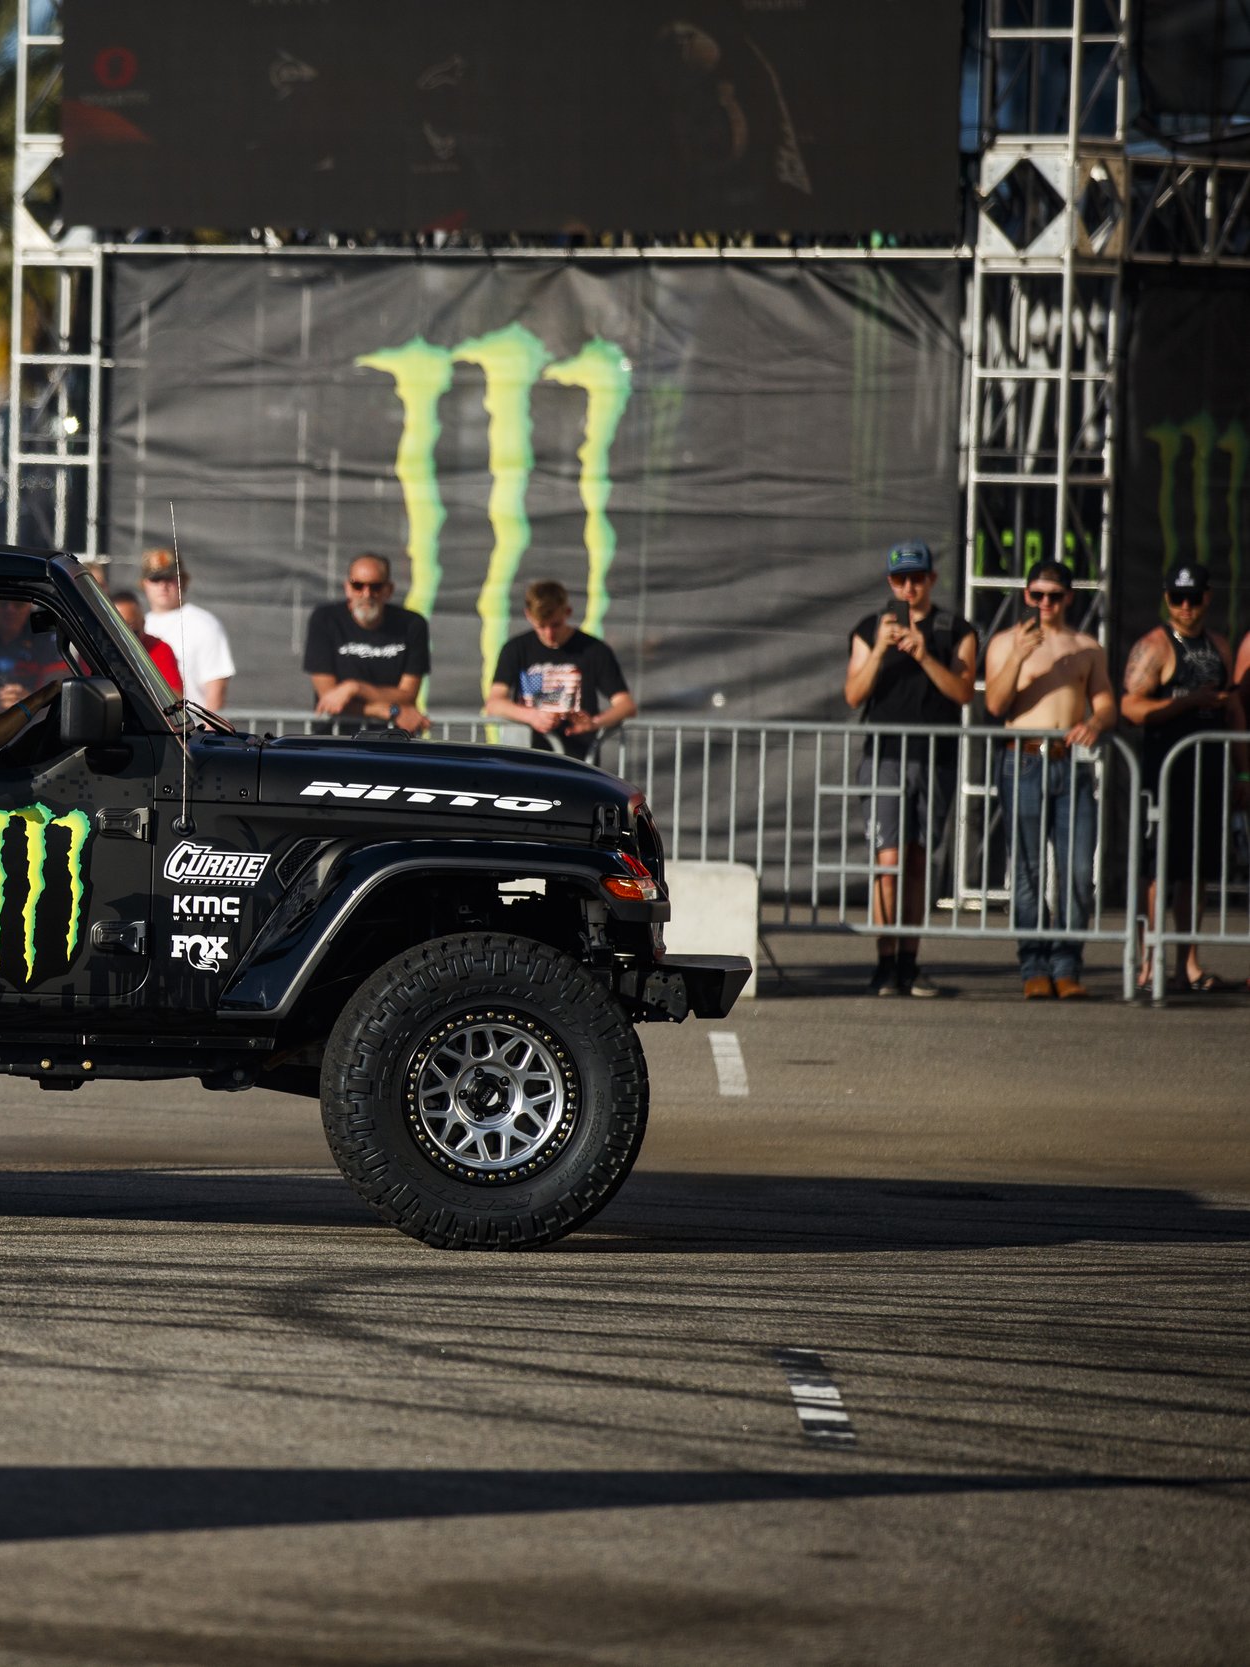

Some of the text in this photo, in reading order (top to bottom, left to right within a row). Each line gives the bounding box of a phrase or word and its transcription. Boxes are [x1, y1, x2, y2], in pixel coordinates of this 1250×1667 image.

[166, 843, 266, 879] CURRIE
[173, 895, 240, 915] KMC
[171, 934, 229, 970] FOX
